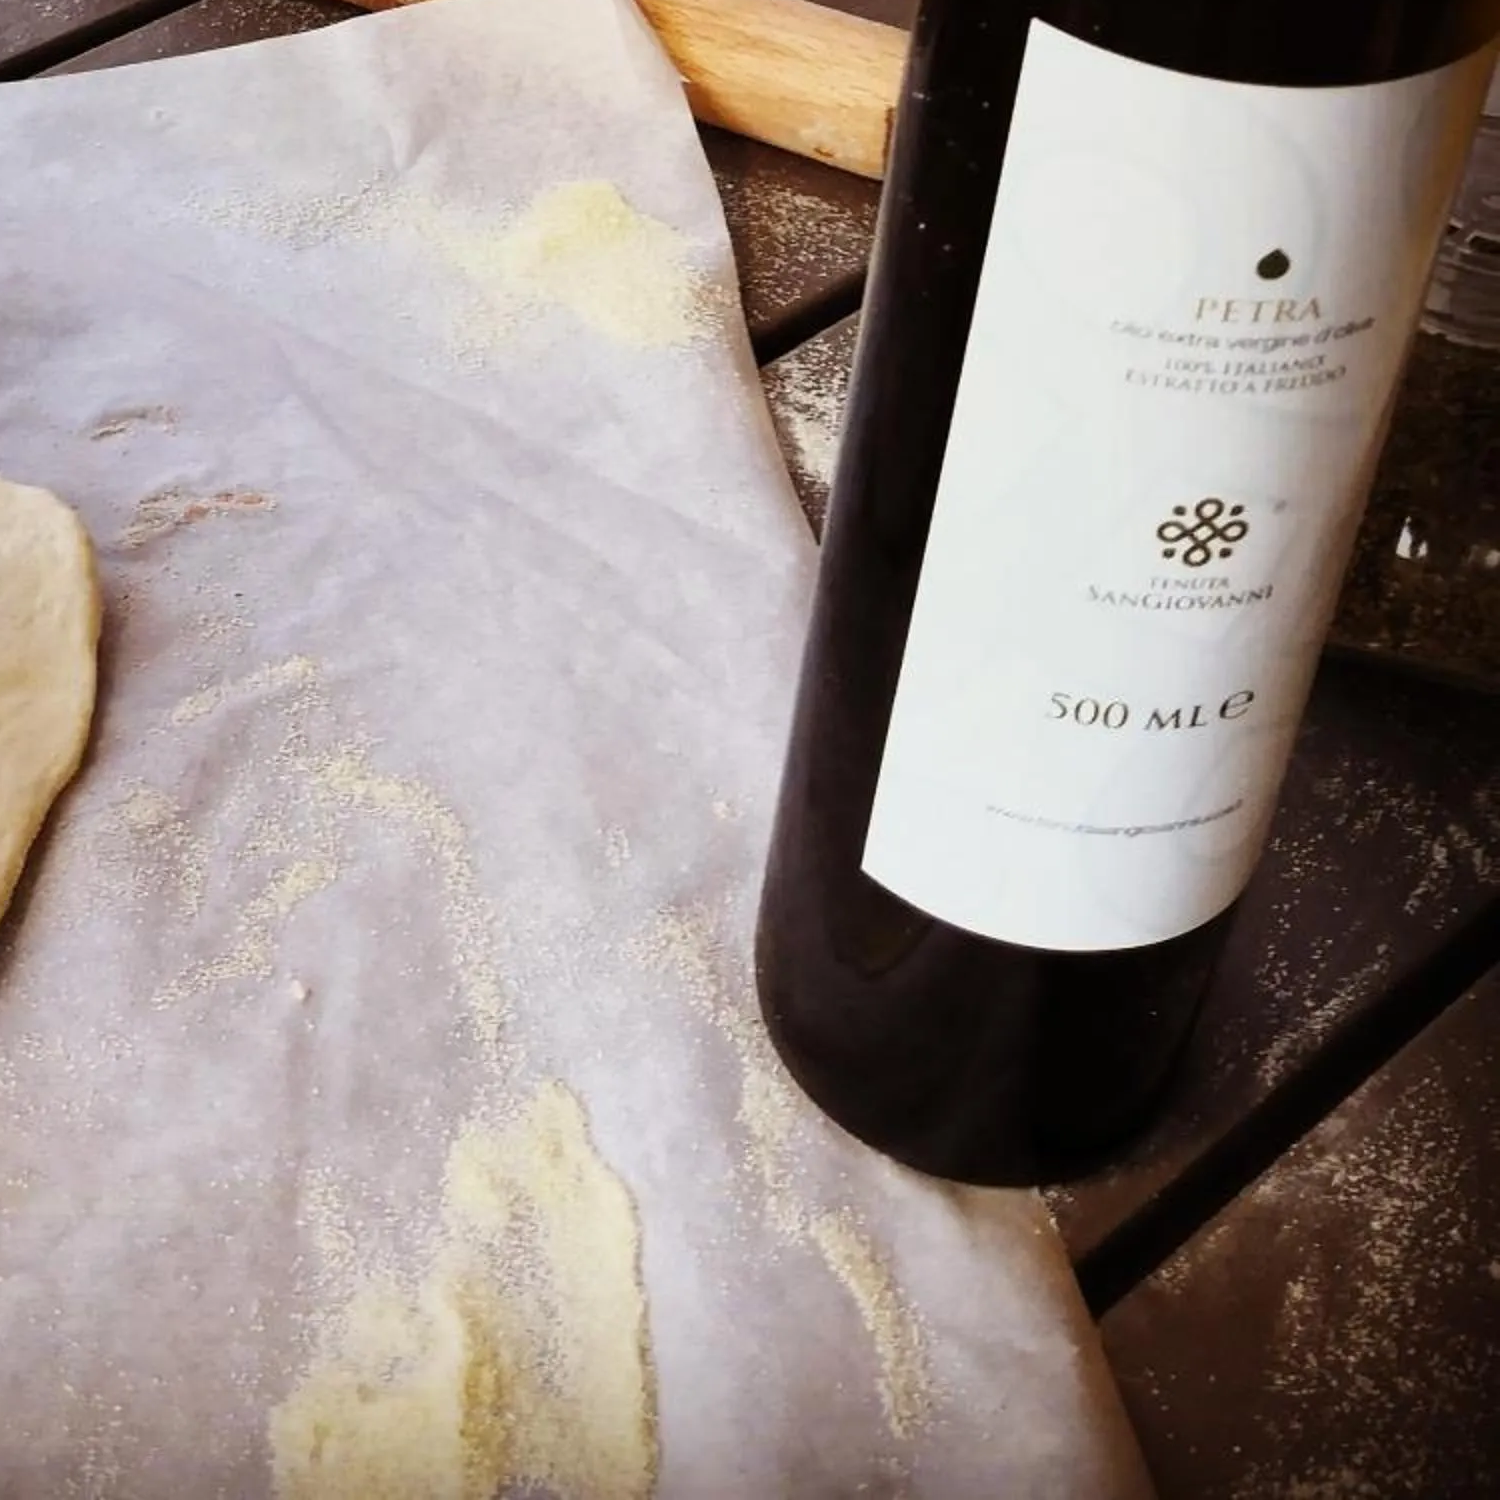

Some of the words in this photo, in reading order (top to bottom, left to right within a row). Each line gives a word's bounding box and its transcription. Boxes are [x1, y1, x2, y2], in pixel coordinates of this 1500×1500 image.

[1193, 297, 1322, 324] PETRA
[1150, 576, 1230, 590] TENUTA
[1048, 692, 1130, 730] 500
[1144, 704, 1207, 731] ML
